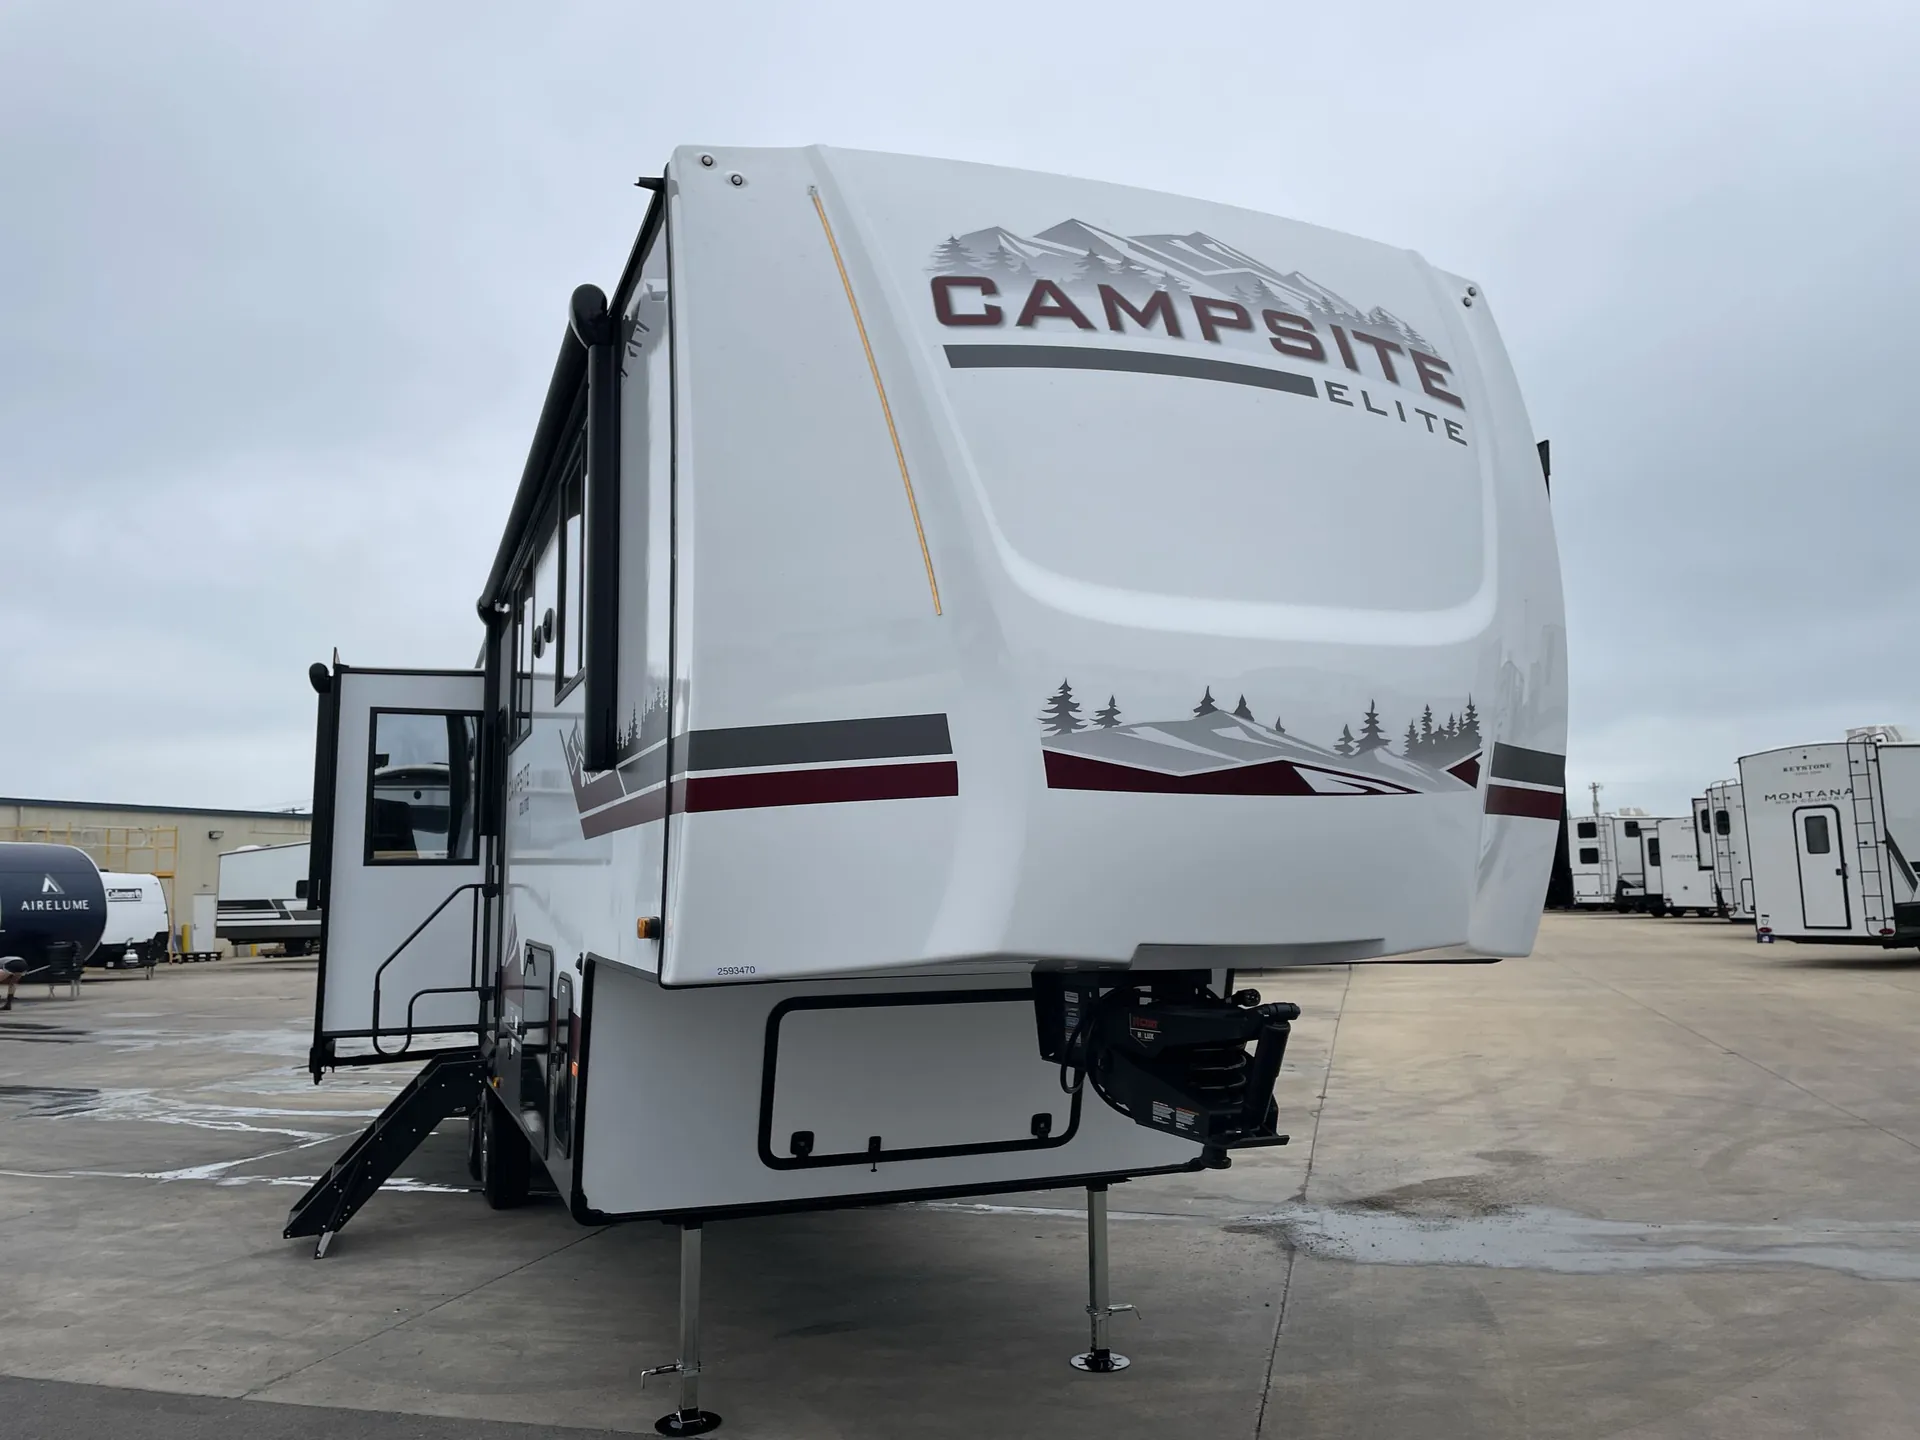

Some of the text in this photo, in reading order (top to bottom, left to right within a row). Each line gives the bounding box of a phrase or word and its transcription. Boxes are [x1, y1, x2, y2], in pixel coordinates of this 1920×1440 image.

[930, 275, 1465, 411] CAMPSITE
[1324, 380, 1467, 446] ELITE
[1783, 763, 1831, 772] KEYSTONE
[1764, 788, 1853, 802] MONTANA
[21, 900, 89, 910] AIRELUME
[717, 966, 756, 975] 2593470
